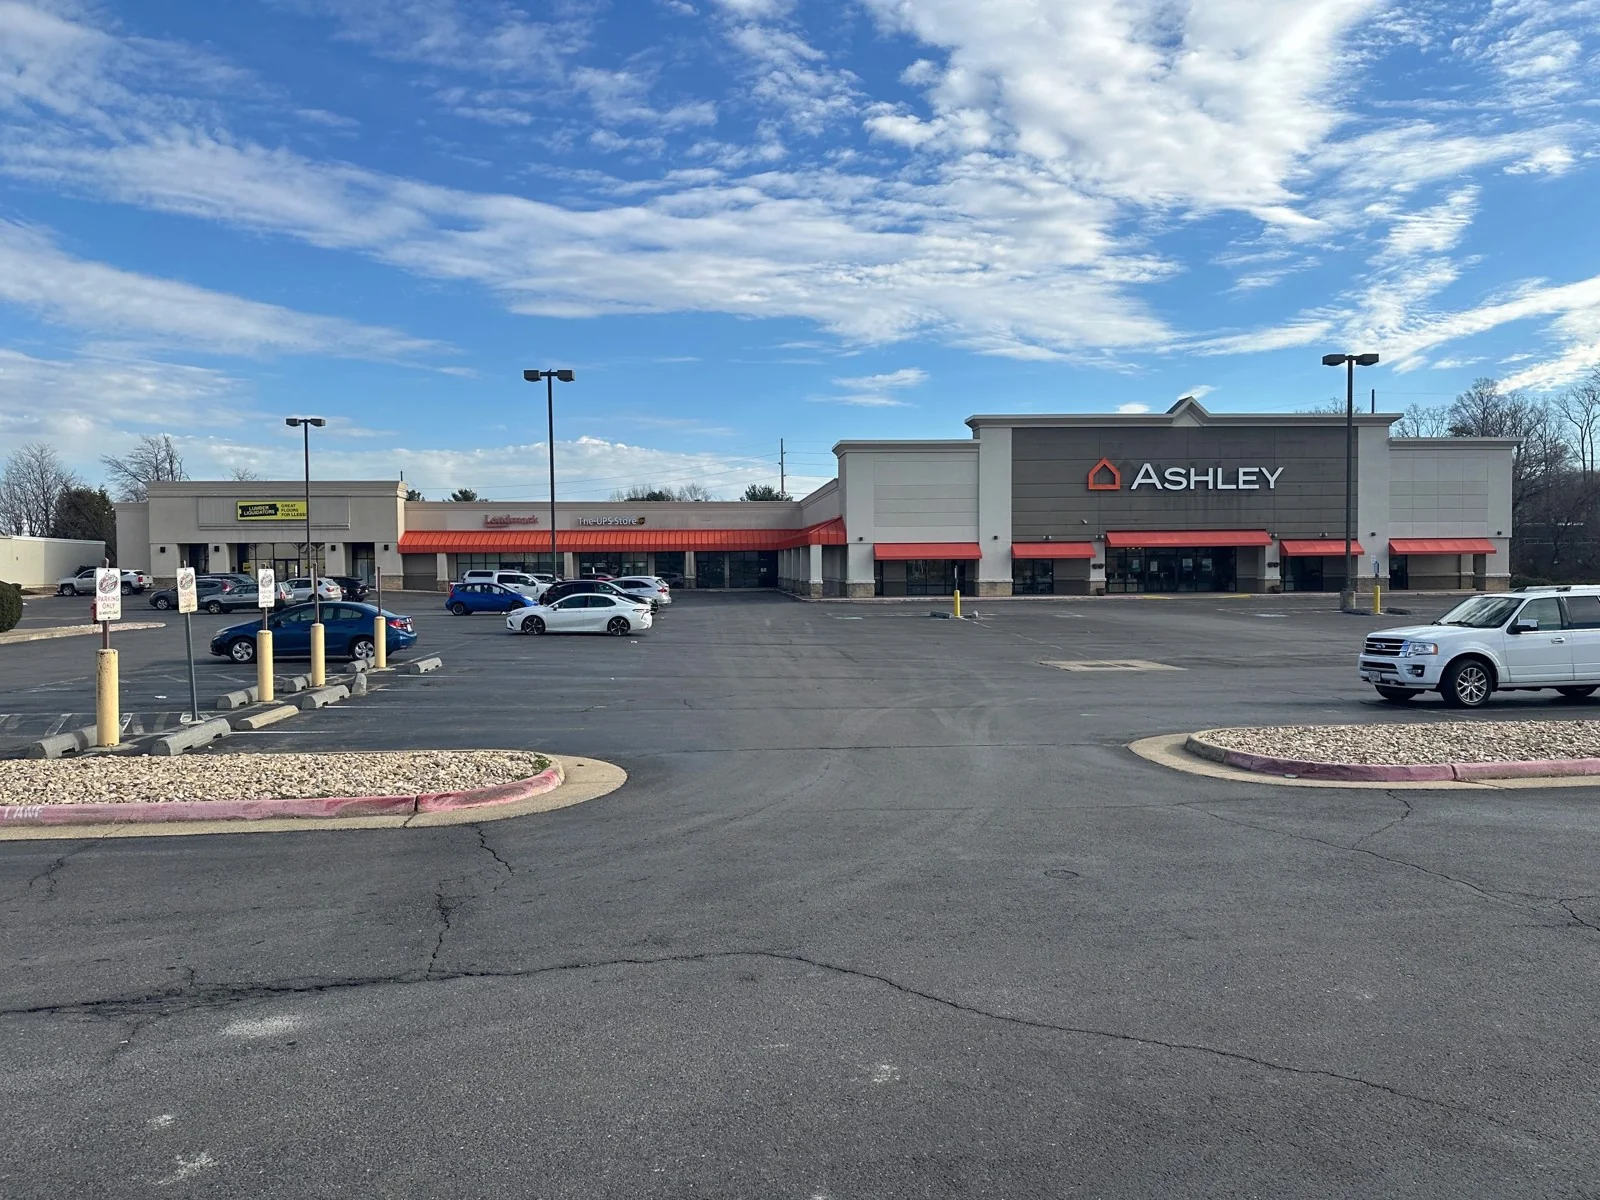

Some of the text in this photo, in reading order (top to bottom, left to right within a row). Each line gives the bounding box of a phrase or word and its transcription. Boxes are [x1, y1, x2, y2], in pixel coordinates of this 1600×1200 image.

[1130, 462, 1285, 490] ASHLEY
[578, 516, 637, 525] The UPS Store
[101, 602, 116, 610] ONLY
